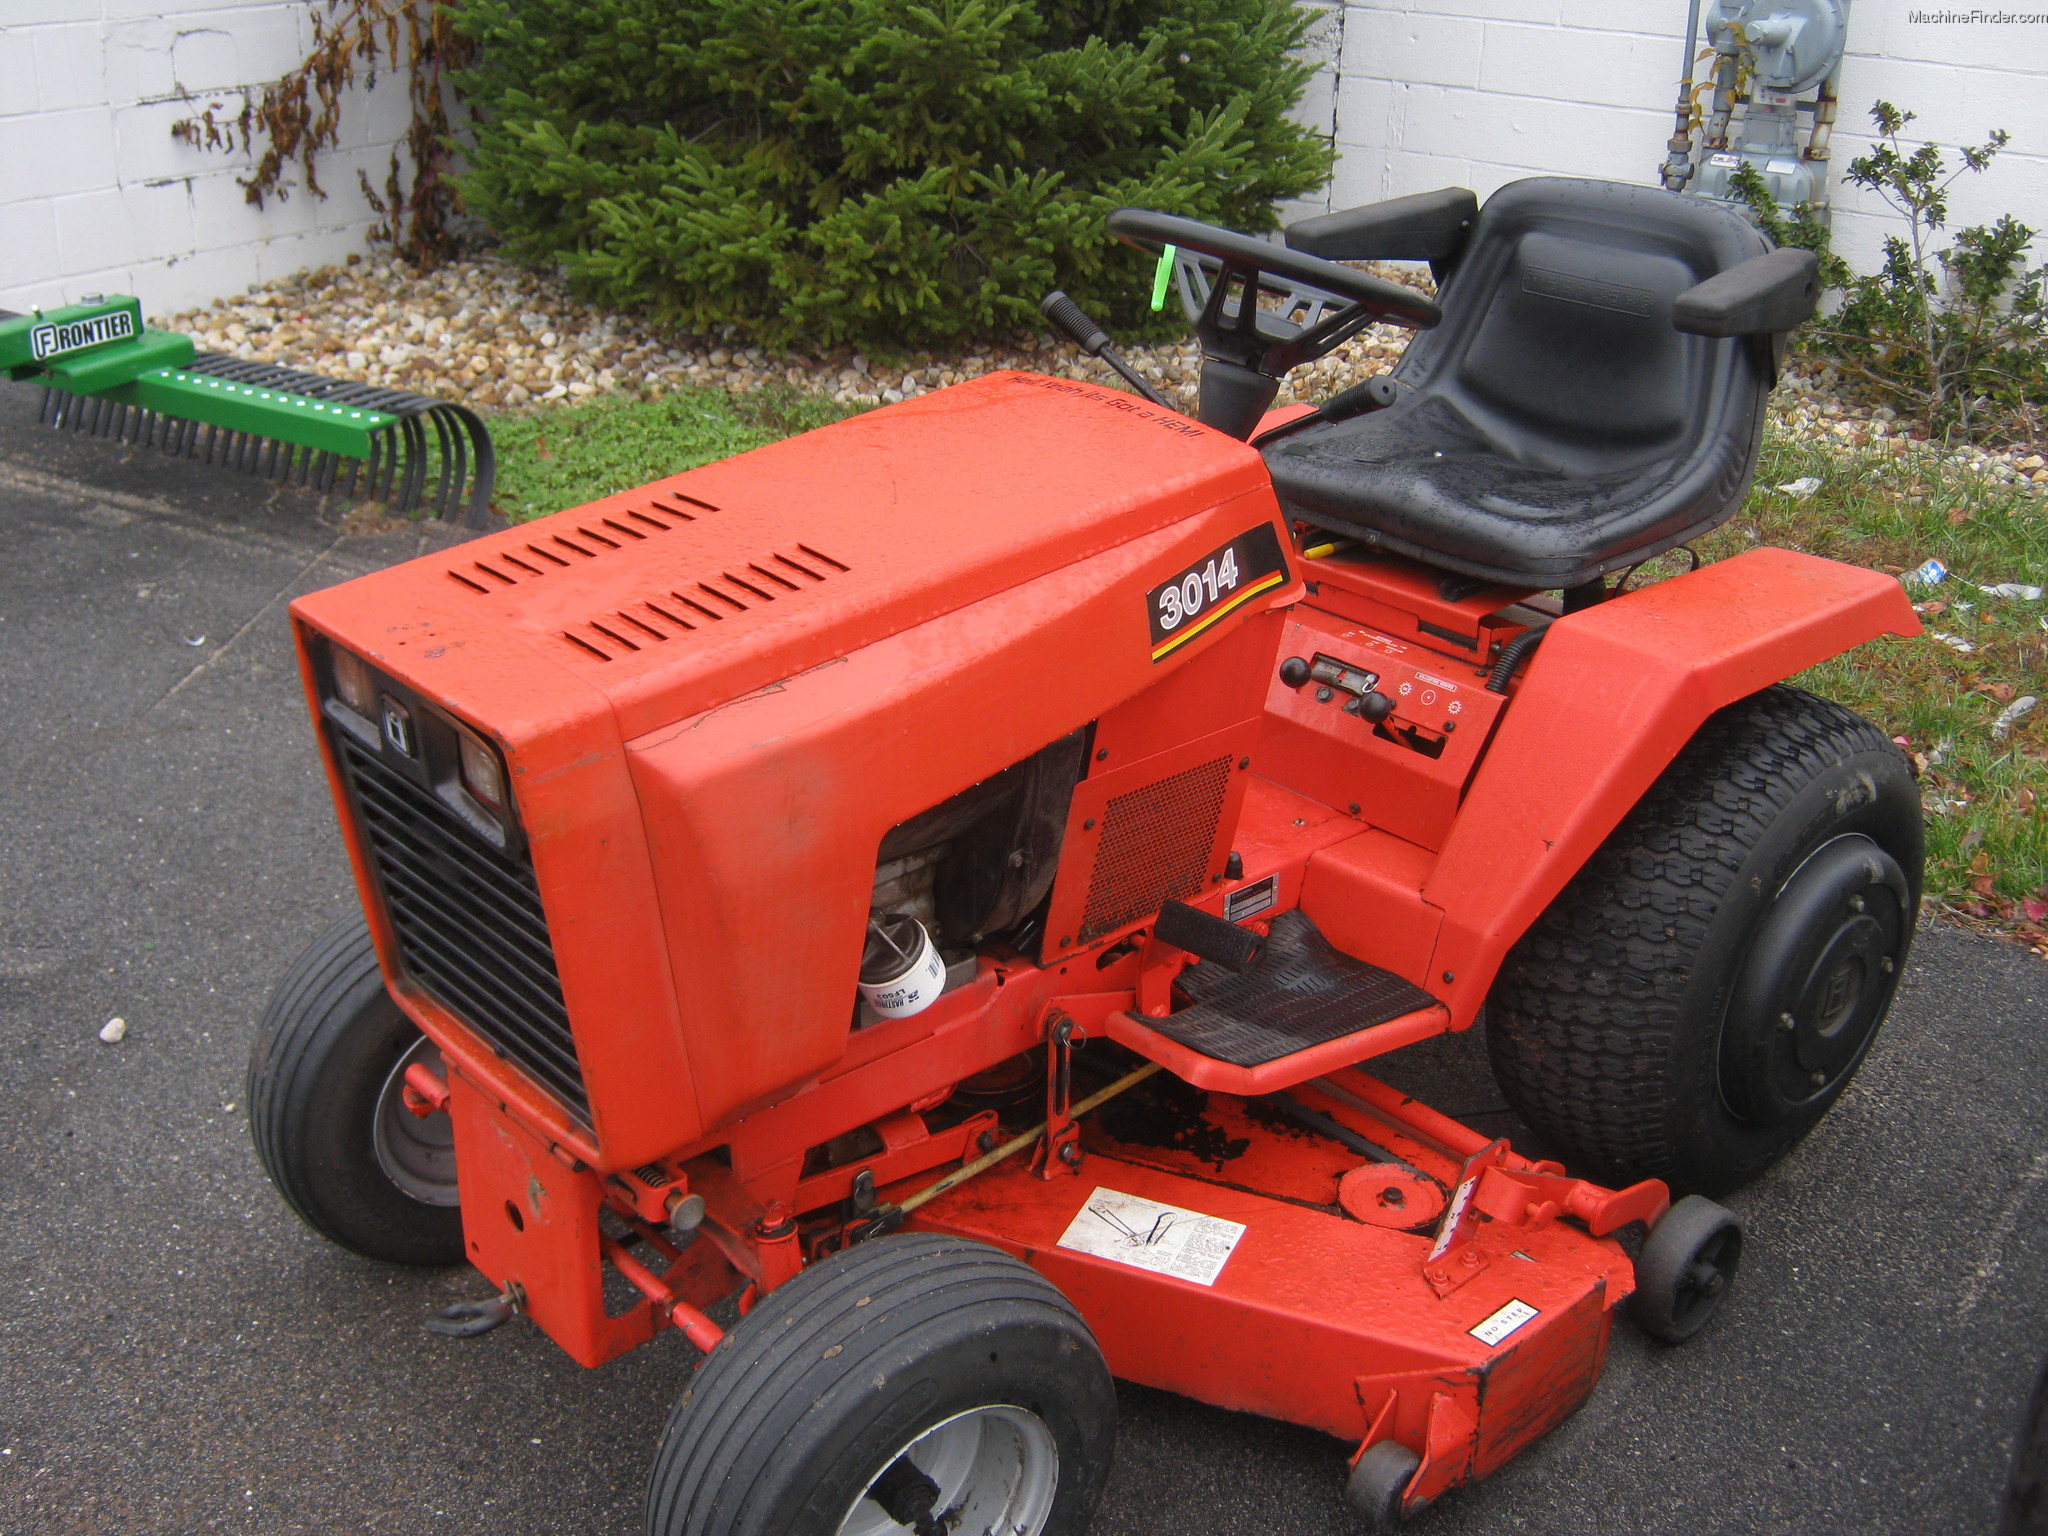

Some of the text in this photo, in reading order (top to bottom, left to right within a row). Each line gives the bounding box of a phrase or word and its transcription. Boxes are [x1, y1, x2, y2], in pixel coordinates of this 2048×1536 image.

[33, 313, 132, 359] FRONTIER
[1105, 398, 1140, 414] Got
[1137, 411, 1155, 419] a
[1153, 416, 1205, 438] HEMI
[1159, 547, 1239, 631] 3014
[1484, 1308, 1524, 1338] NO STEP
